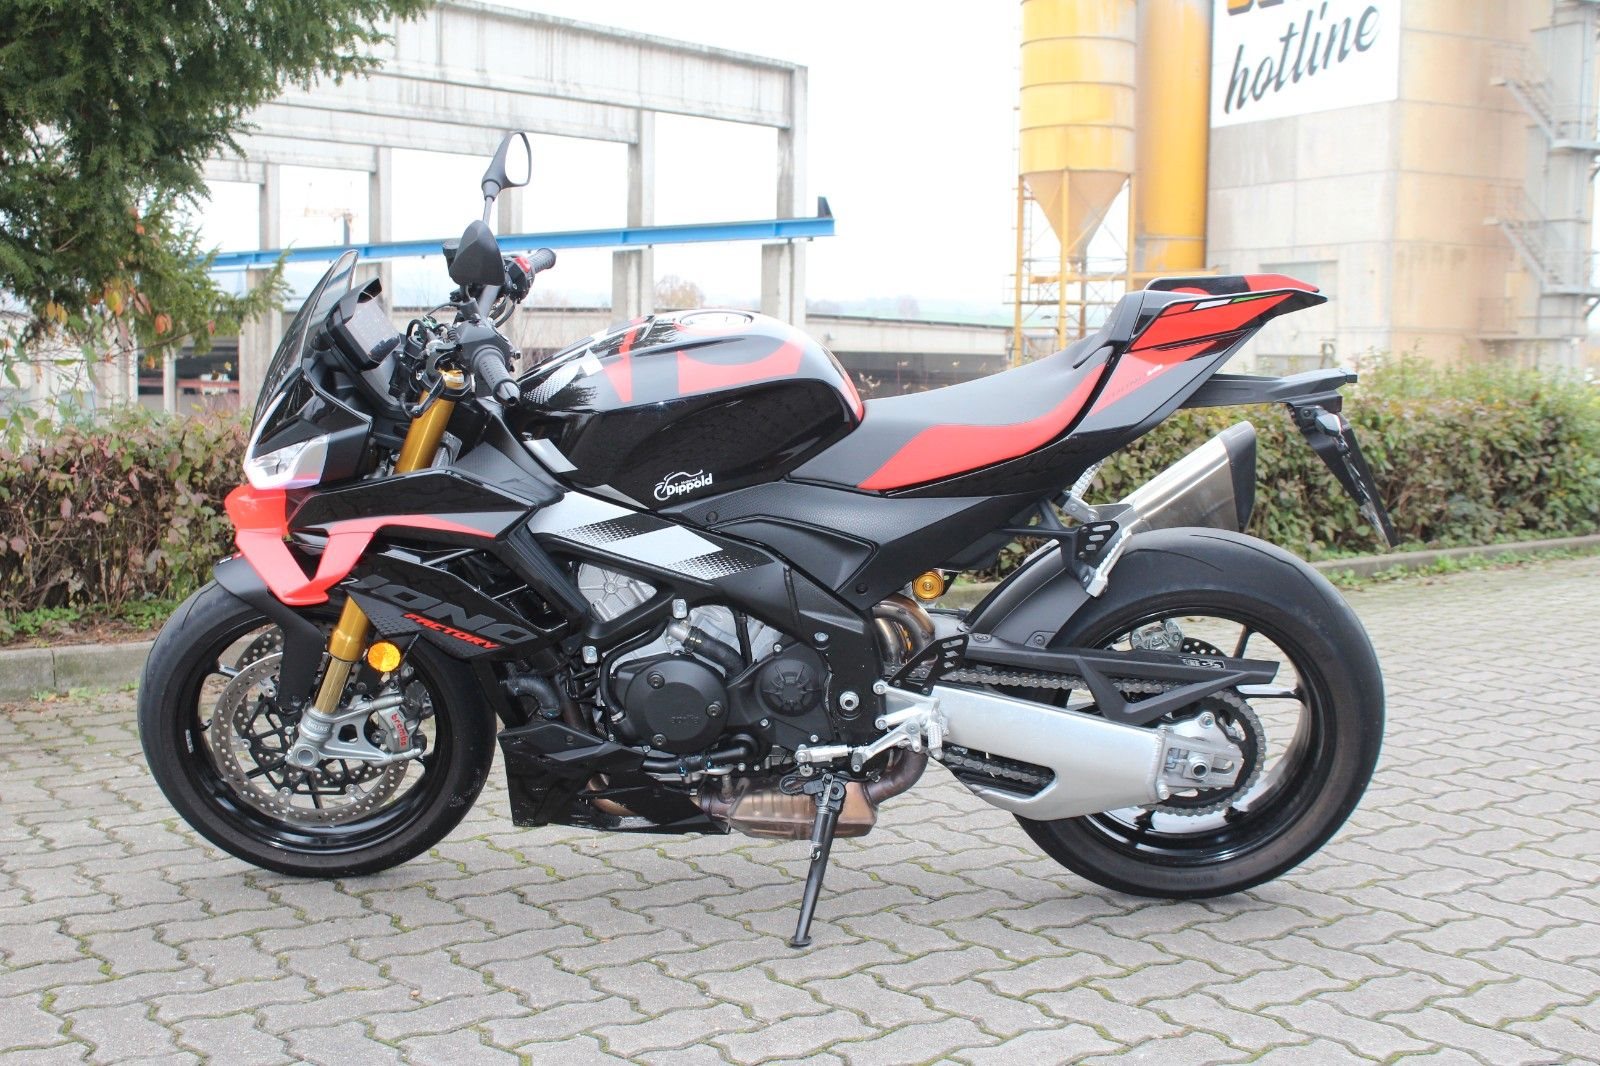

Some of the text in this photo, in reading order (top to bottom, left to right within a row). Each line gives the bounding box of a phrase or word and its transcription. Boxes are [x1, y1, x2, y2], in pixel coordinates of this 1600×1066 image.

[1224, 1, 1379, 114] hotline
[666, 472, 713, 496] Dippold
[403, 612, 503, 650] FACTORY
[391, 713, 408, 746] brembo
